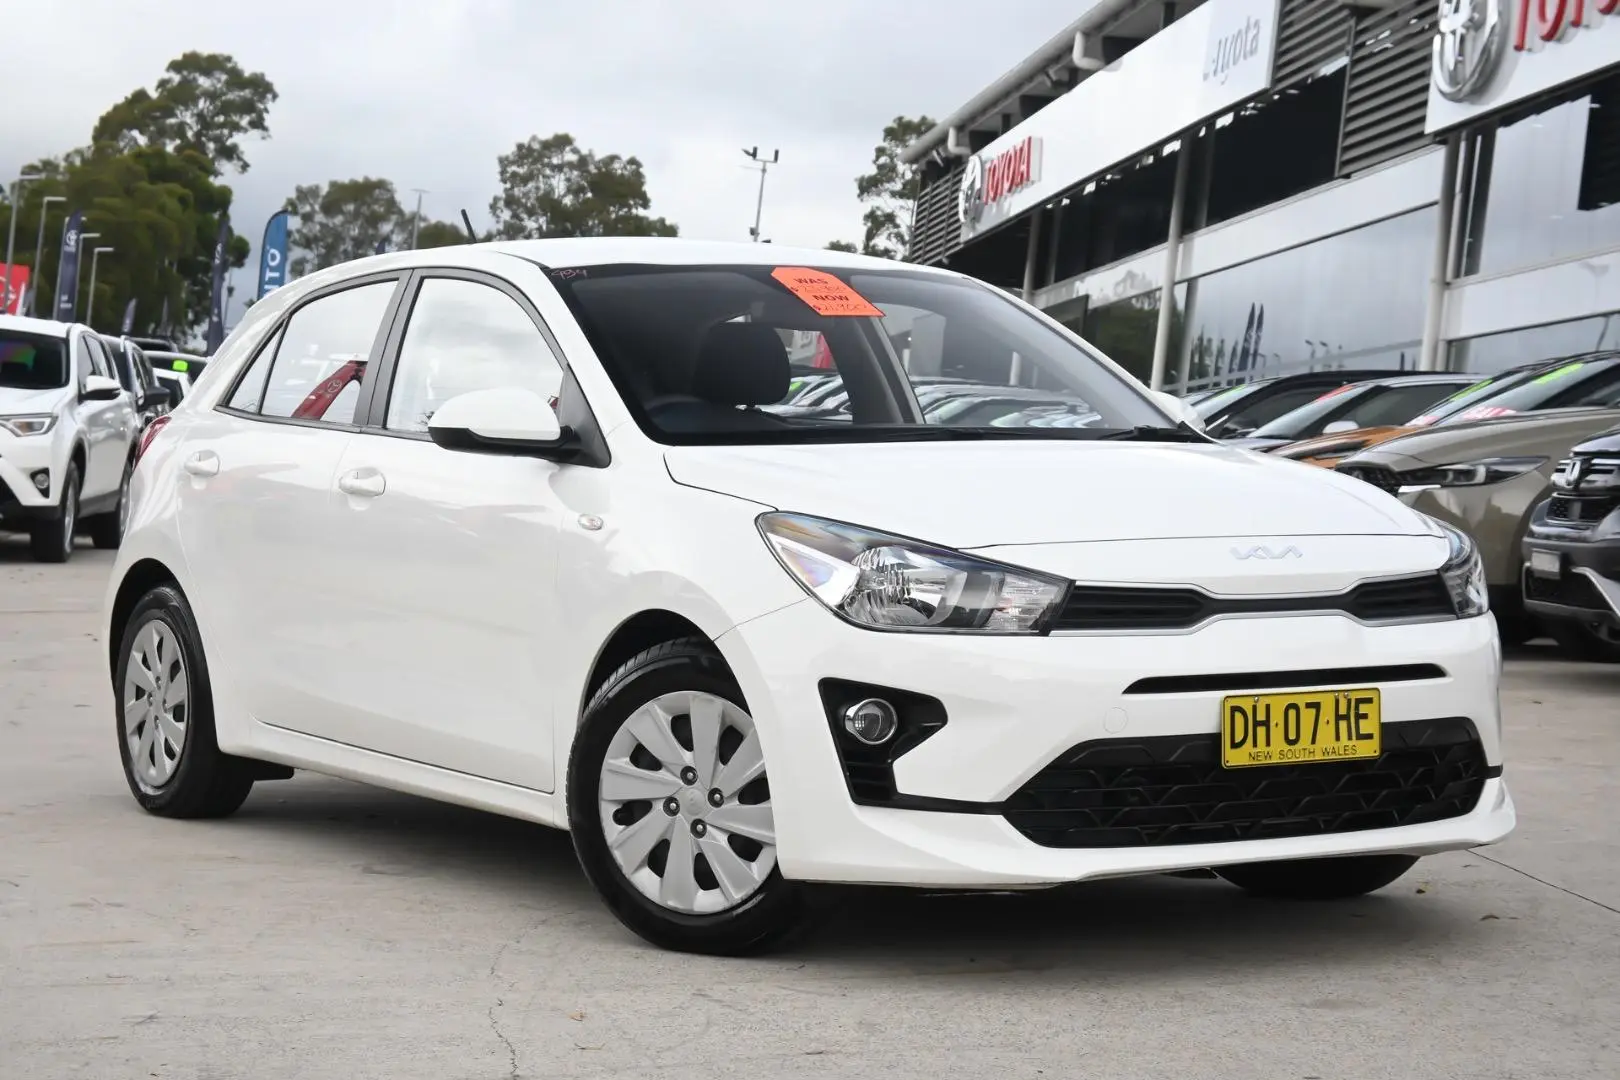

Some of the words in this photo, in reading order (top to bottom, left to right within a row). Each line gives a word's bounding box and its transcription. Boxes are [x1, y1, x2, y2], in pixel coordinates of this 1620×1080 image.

[981, 136, 1032, 205] TOYOTA
[794, 277, 829, 285] WAS
[812, 294, 851, 302] NOW
[1248, 750, 1273, 762] NEW
[1278, 747, 1316, 760] SOUTH
[1321, 744, 1358, 757] WALES
